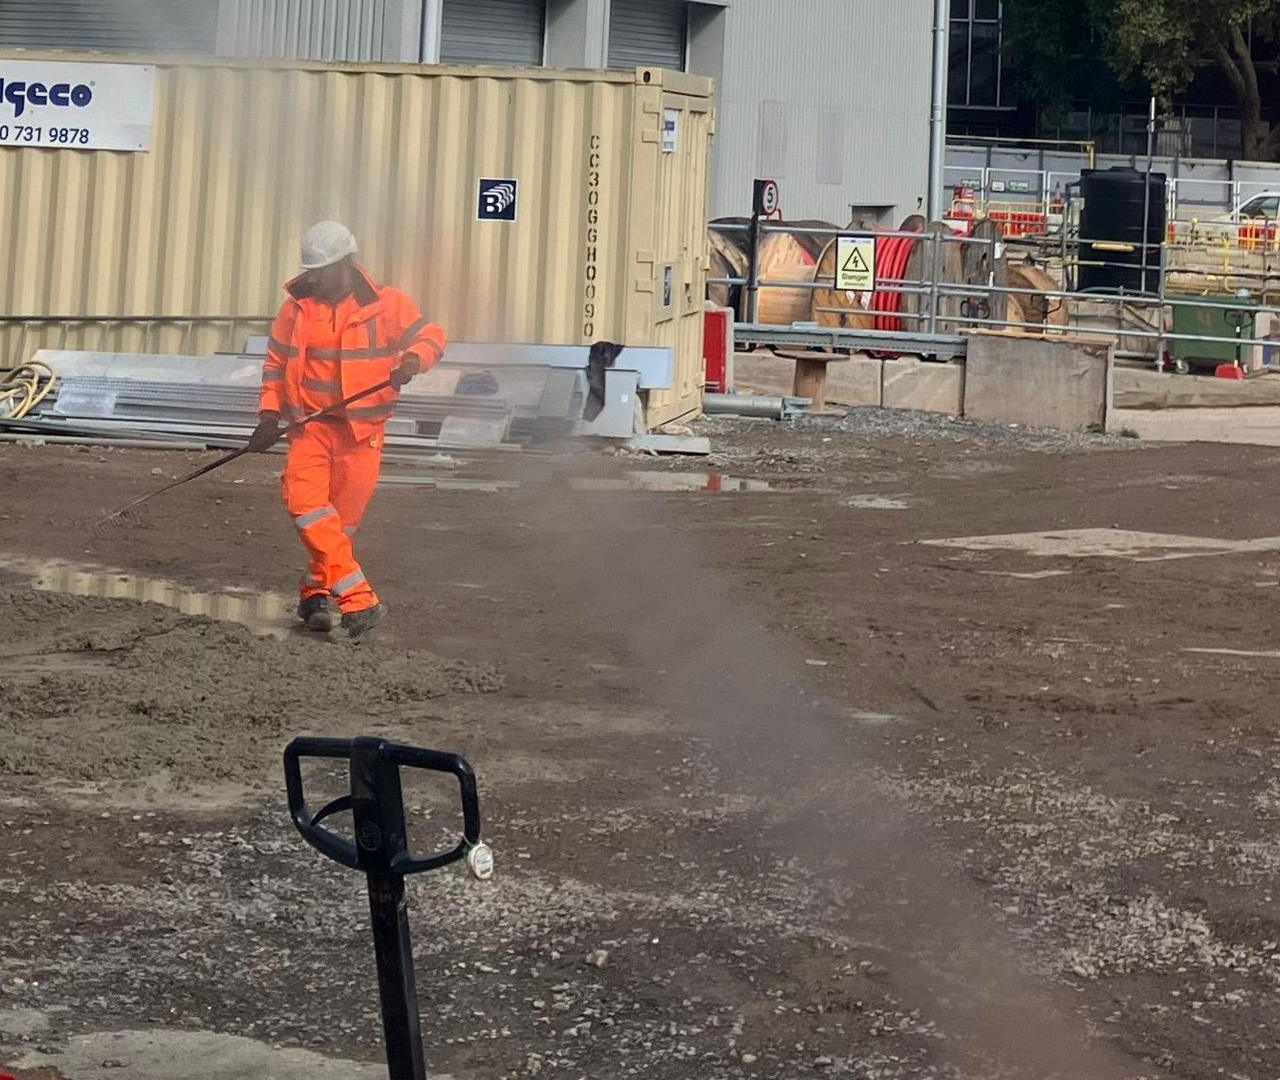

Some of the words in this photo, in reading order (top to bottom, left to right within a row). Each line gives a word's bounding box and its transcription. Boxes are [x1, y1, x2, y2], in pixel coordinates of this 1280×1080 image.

[14, 125, 43, 142] 731
[48, 127, 90, 145] 9878
[766, 186, 774, 204] 5
[841, 273, 869, 281] Danger
